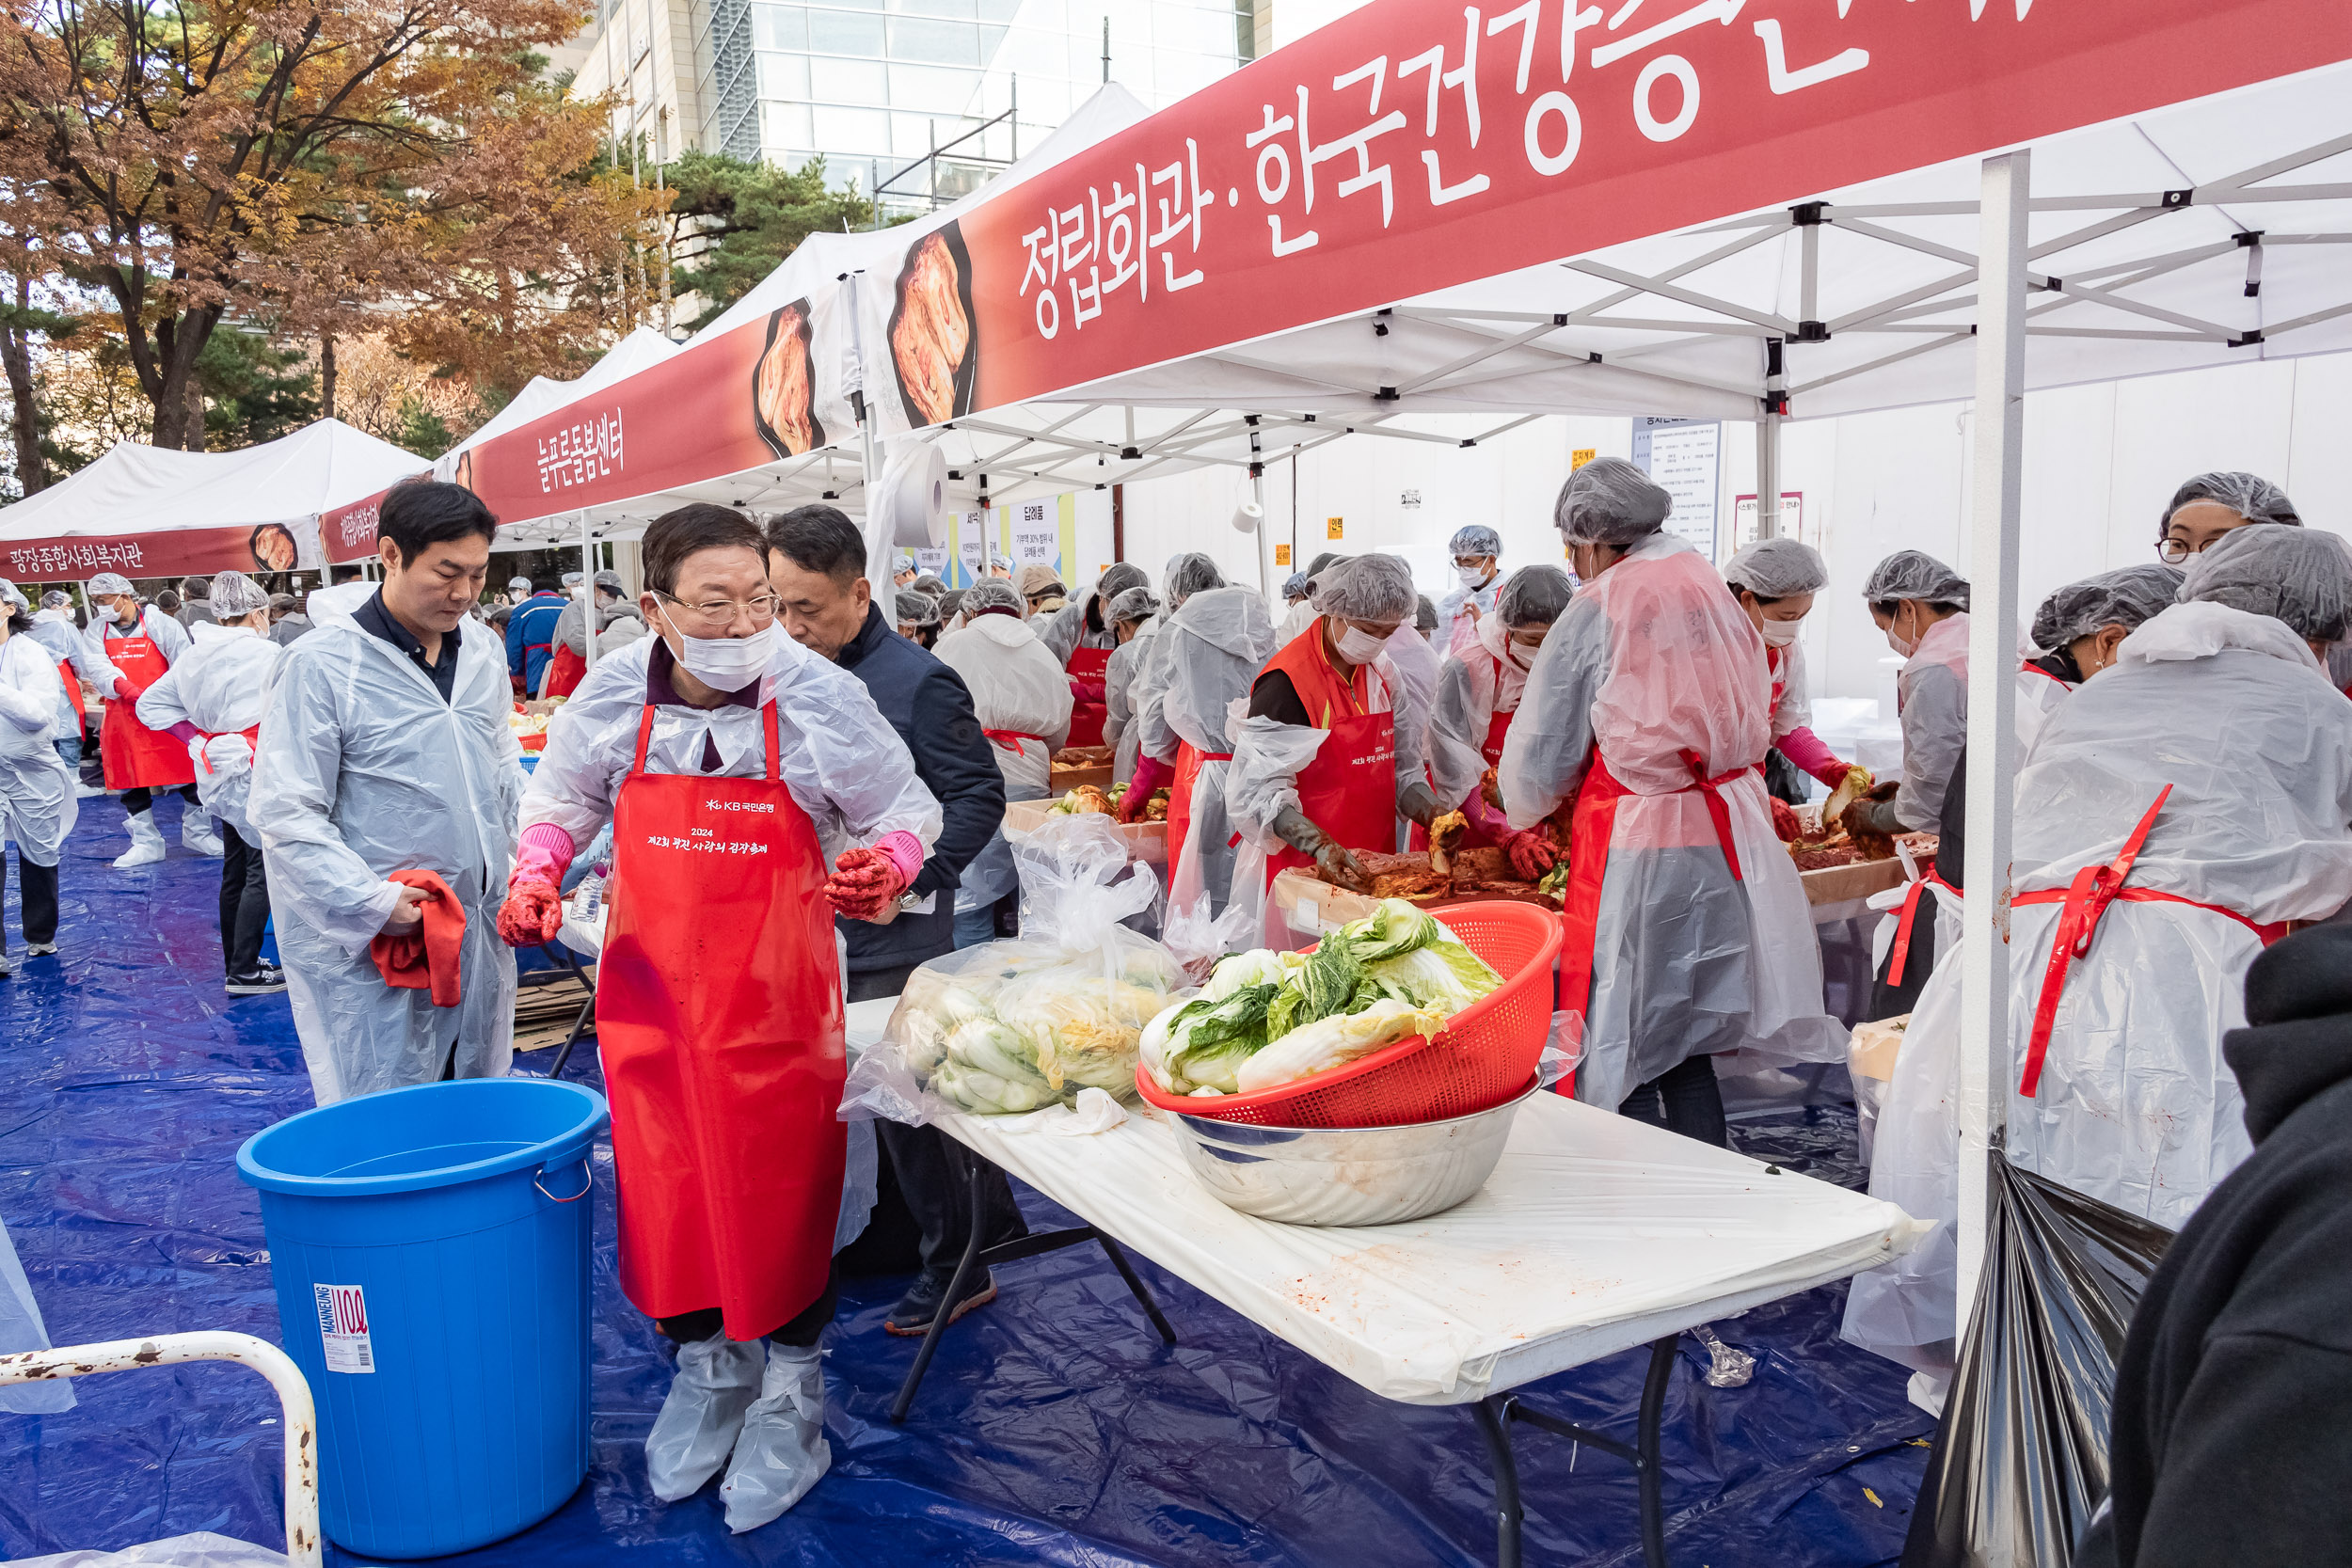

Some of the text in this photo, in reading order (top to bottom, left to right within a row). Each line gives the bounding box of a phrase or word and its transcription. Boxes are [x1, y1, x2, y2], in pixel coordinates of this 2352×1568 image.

[537, 405, 624, 493] 늘푸른돌봄센터
[1024, 505, 1043, 521] 답례품
[1016, 532, 1053, 545] 기부액 30% 범위 내
[9, 541, 144, 574] 광장종합사회복지관
[1024, 546, 1046, 558] 답례품 선택
[691, 828, 713, 837] 2024
[646, 835, 768, 856] 제2회 광진 사랑의 김장축제
[315, 1286, 337, 1334] MANNEUNG
